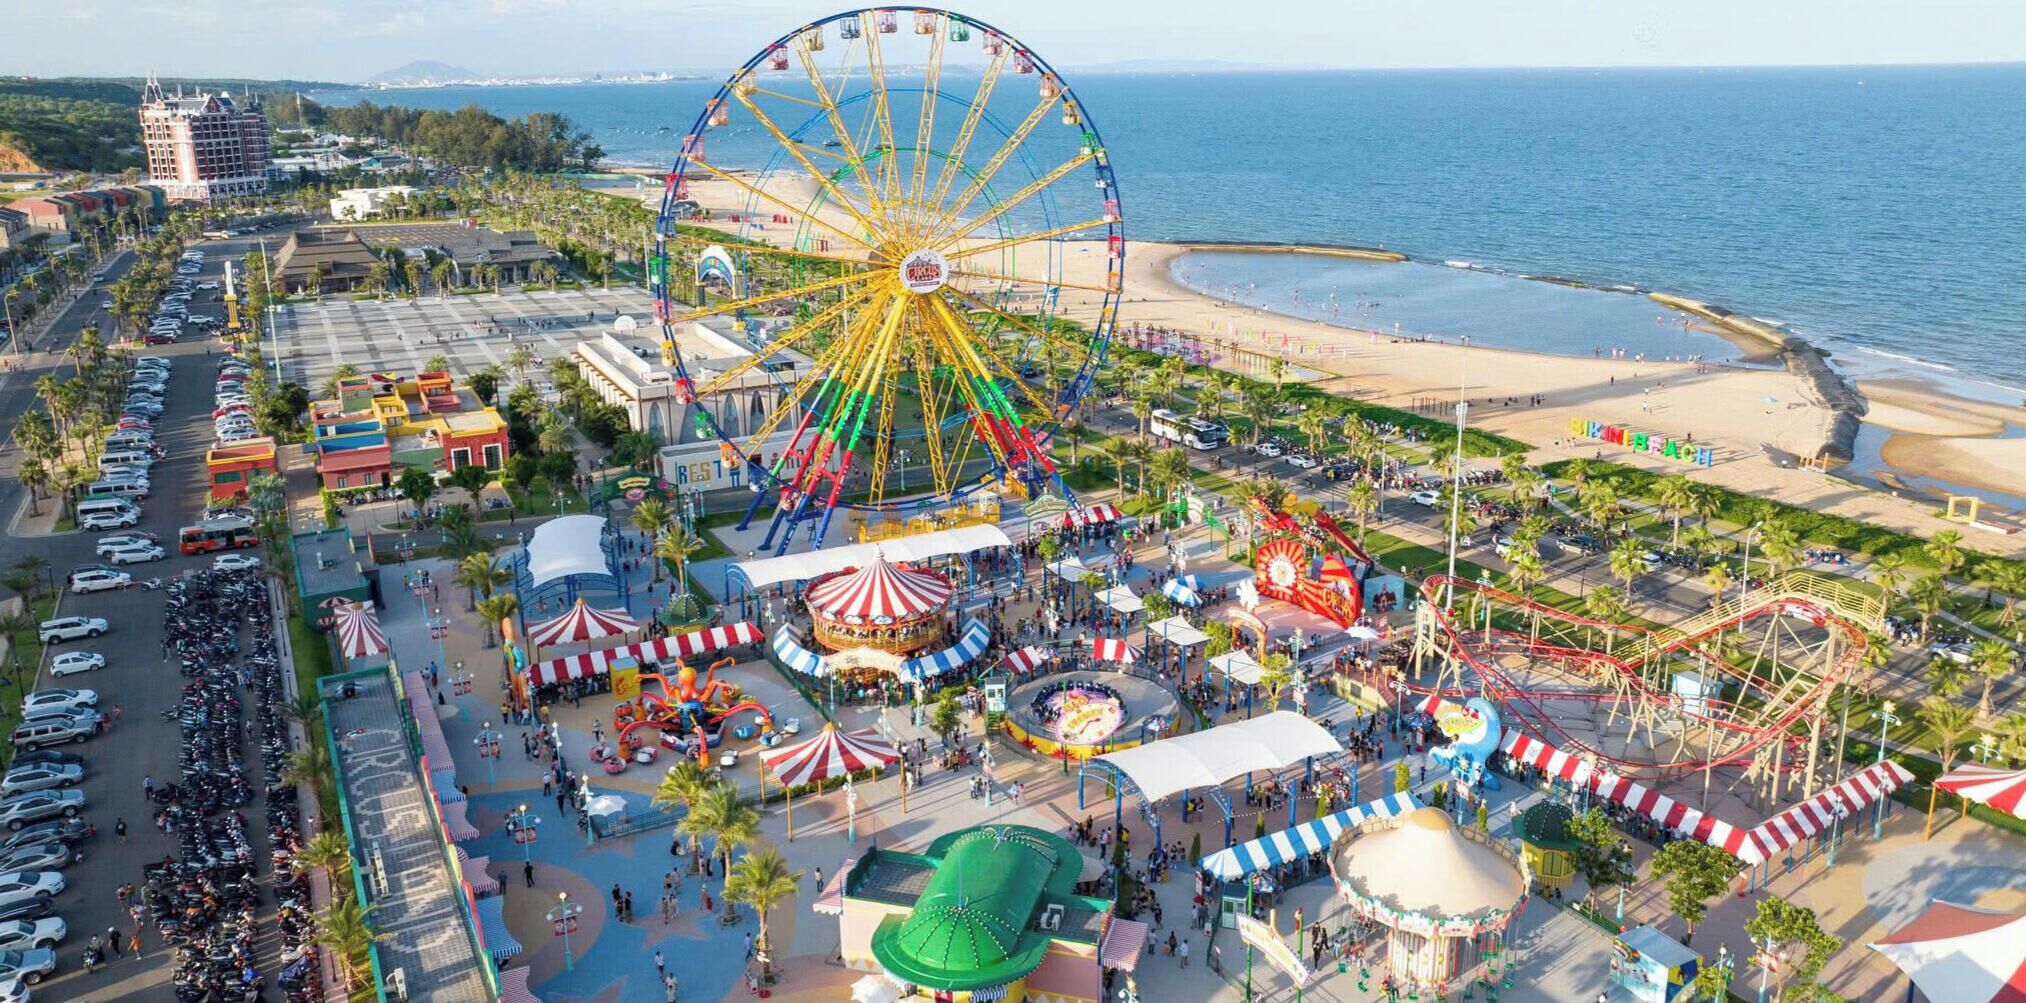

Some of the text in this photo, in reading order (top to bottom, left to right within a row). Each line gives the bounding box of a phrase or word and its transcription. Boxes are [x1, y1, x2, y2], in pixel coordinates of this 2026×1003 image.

[907, 266, 941, 280] CIRCUS
[1571, 417, 1712, 467] BIKINI BEACH
